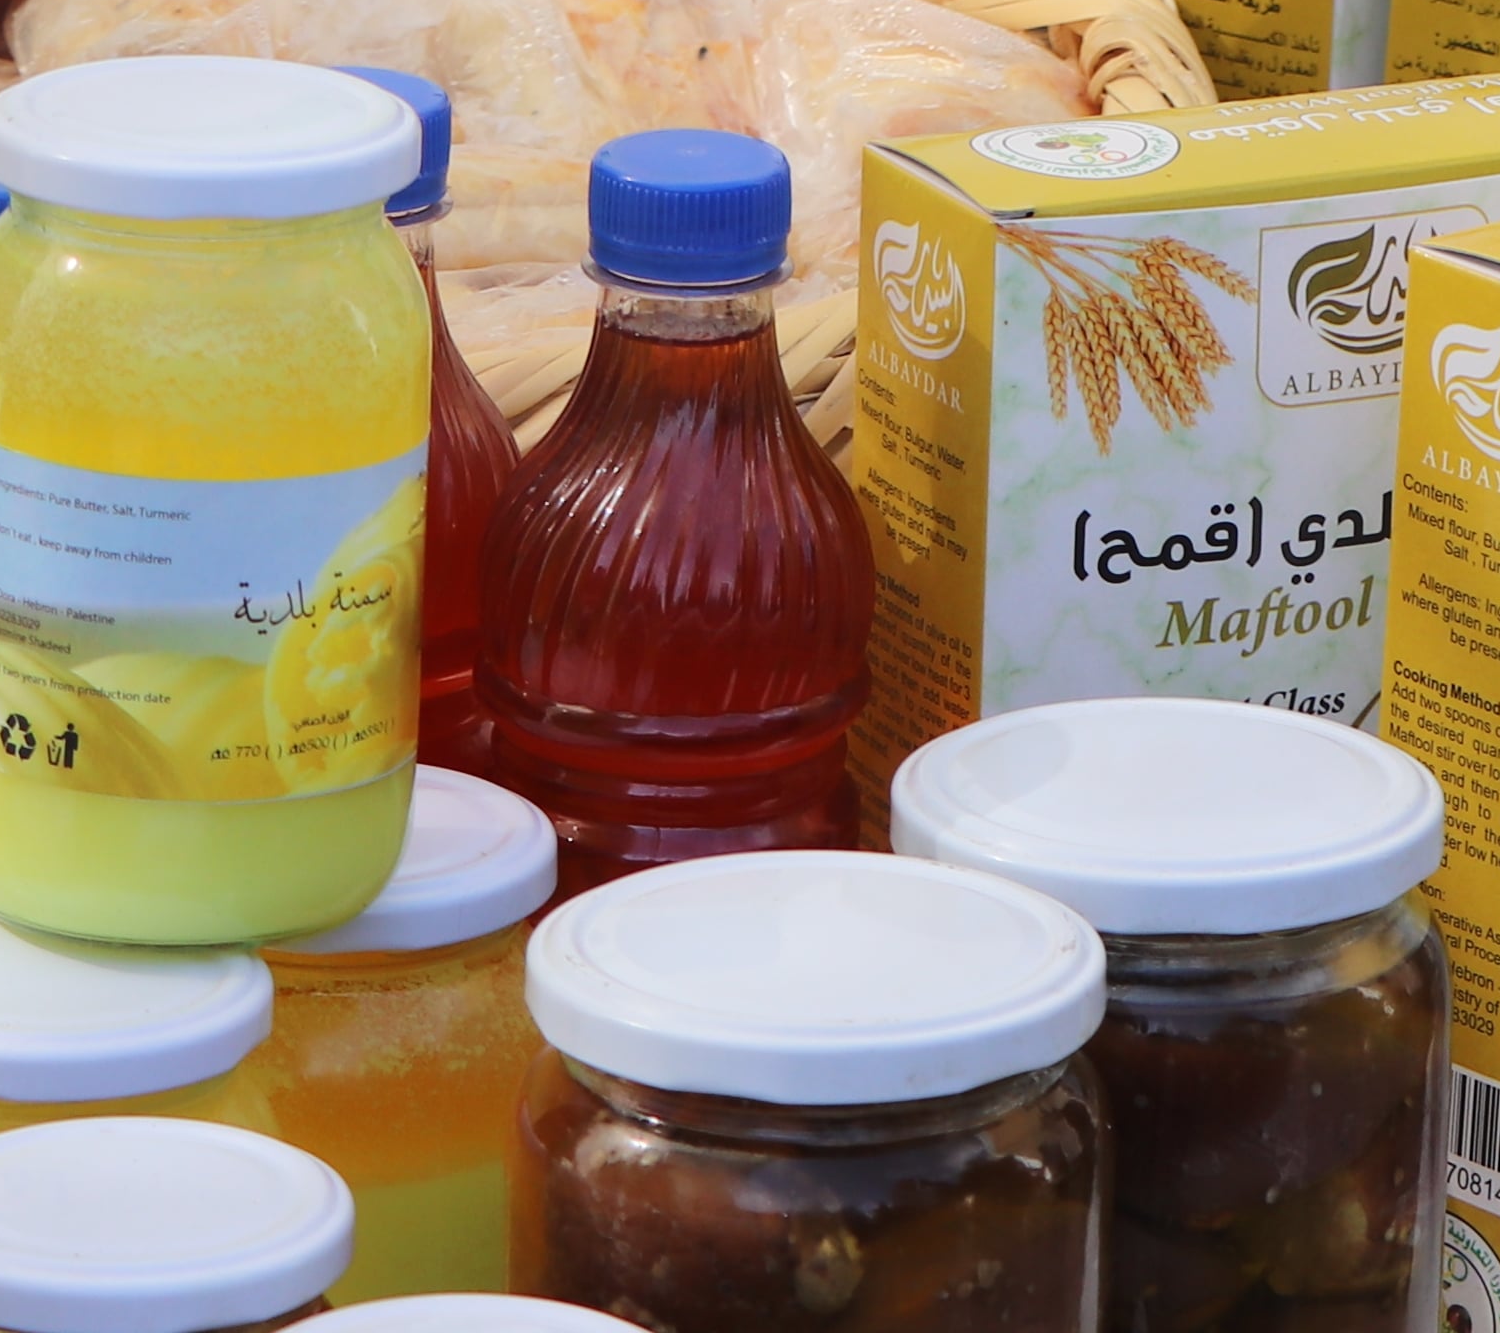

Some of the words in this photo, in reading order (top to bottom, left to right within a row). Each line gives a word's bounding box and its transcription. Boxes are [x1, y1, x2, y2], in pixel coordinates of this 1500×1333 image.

[1187, 111, 1337, 142] مفتول
[1349, 97, 1454, 125] بلدي
[1216, 95, 1354, 118] Wheat
[869, 341, 964, 414] ALBAYDAR
[1282, 361, 1402, 396] ALBAY
[49, 493, 71, 507] Pure
[75, 499, 109, 514] Butter,
[113, 505, 136, 517] Salt,
[140, 507, 191, 520] Turmeric
[1402, 473, 1468, 513] Contents:
[1073, 496, 1263, 584] (قمح)
[1281, 490, 1392, 585] لدي
[1408, 503, 1445, 530] Mixed
[1449, 519, 1479, 546] flour,
[1444, 540, 1468, 562] Salt
[234, 579, 316, 635] بلدية
[331, 572, 392, 611] سمنة
[1401, 590, 1439, 615] where
[1443, 607, 1482, 632] gluten
[1419, 573, 1481, 610] Allergens:
[1155, 575, 1374, 657] Maftool
[1450, 630, 1466, 646] be
[3, 664, 19, 679] two
[22, 671, 46, 688] years
[50, 678, 74, 695] from
[78, 684, 140, 703] production
[144, 692, 171, 704] date
[1393, 660, 1448, 698] Cooking
[1391, 682, 1416, 702] Add
[1420, 694, 1441, 714] two
[1445, 706, 1491, 734] spoons
[1391, 703, 1409, 722] the
[1417, 715, 1464, 745] desired
[1389, 723, 1434, 753] Maftool
[1436, 745, 1455, 762] stir
[1458, 755, 1487, 773] over
[1441, 768, 1465, 788] and
[1471, 780, 1500, 801] then
[1445, 792, 1469, 812] ugh
[1478, 802, 1492, 820] to
[1445, 833, 1461, 852] der
[1464, 840, 1487, 860] low
[1453, 985, 1482, 1012] istry
[1486, 1001, 1500, 1017] of
